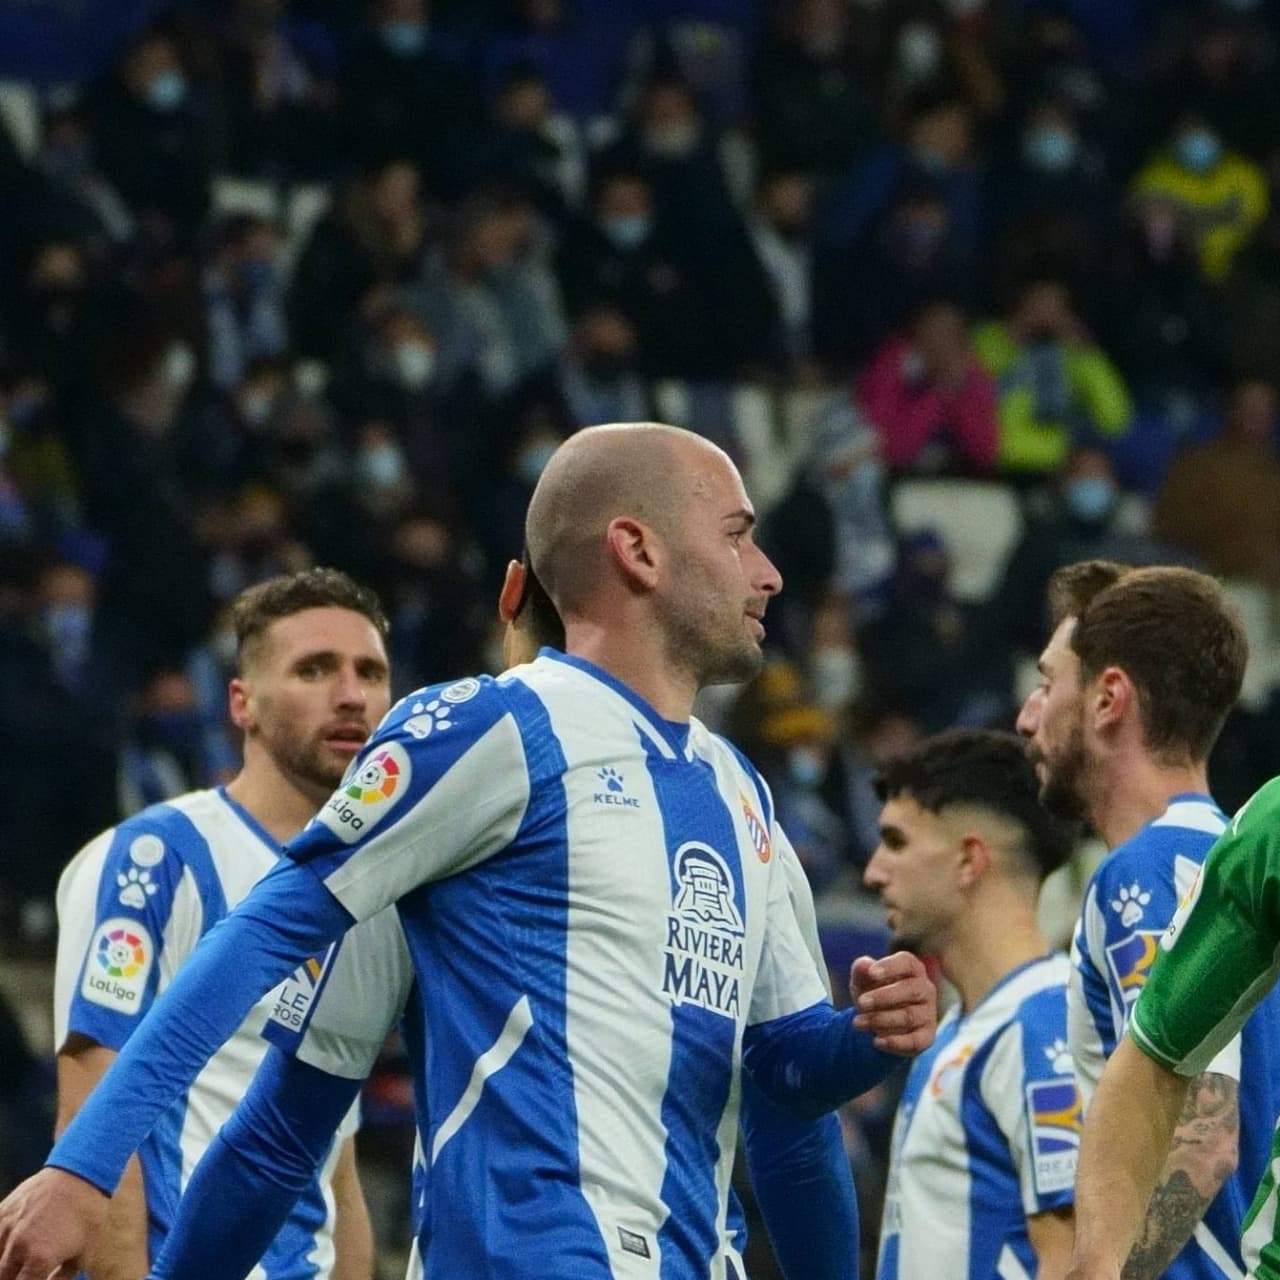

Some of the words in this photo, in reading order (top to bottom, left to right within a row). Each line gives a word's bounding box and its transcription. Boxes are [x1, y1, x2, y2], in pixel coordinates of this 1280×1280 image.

[593, 792, 640, 808] KELME
[667, 916, 744, 971] RIVIERA
[89, 975, 137, 1002] LaLiga
[662, 951, 741, 1018] MAYA
